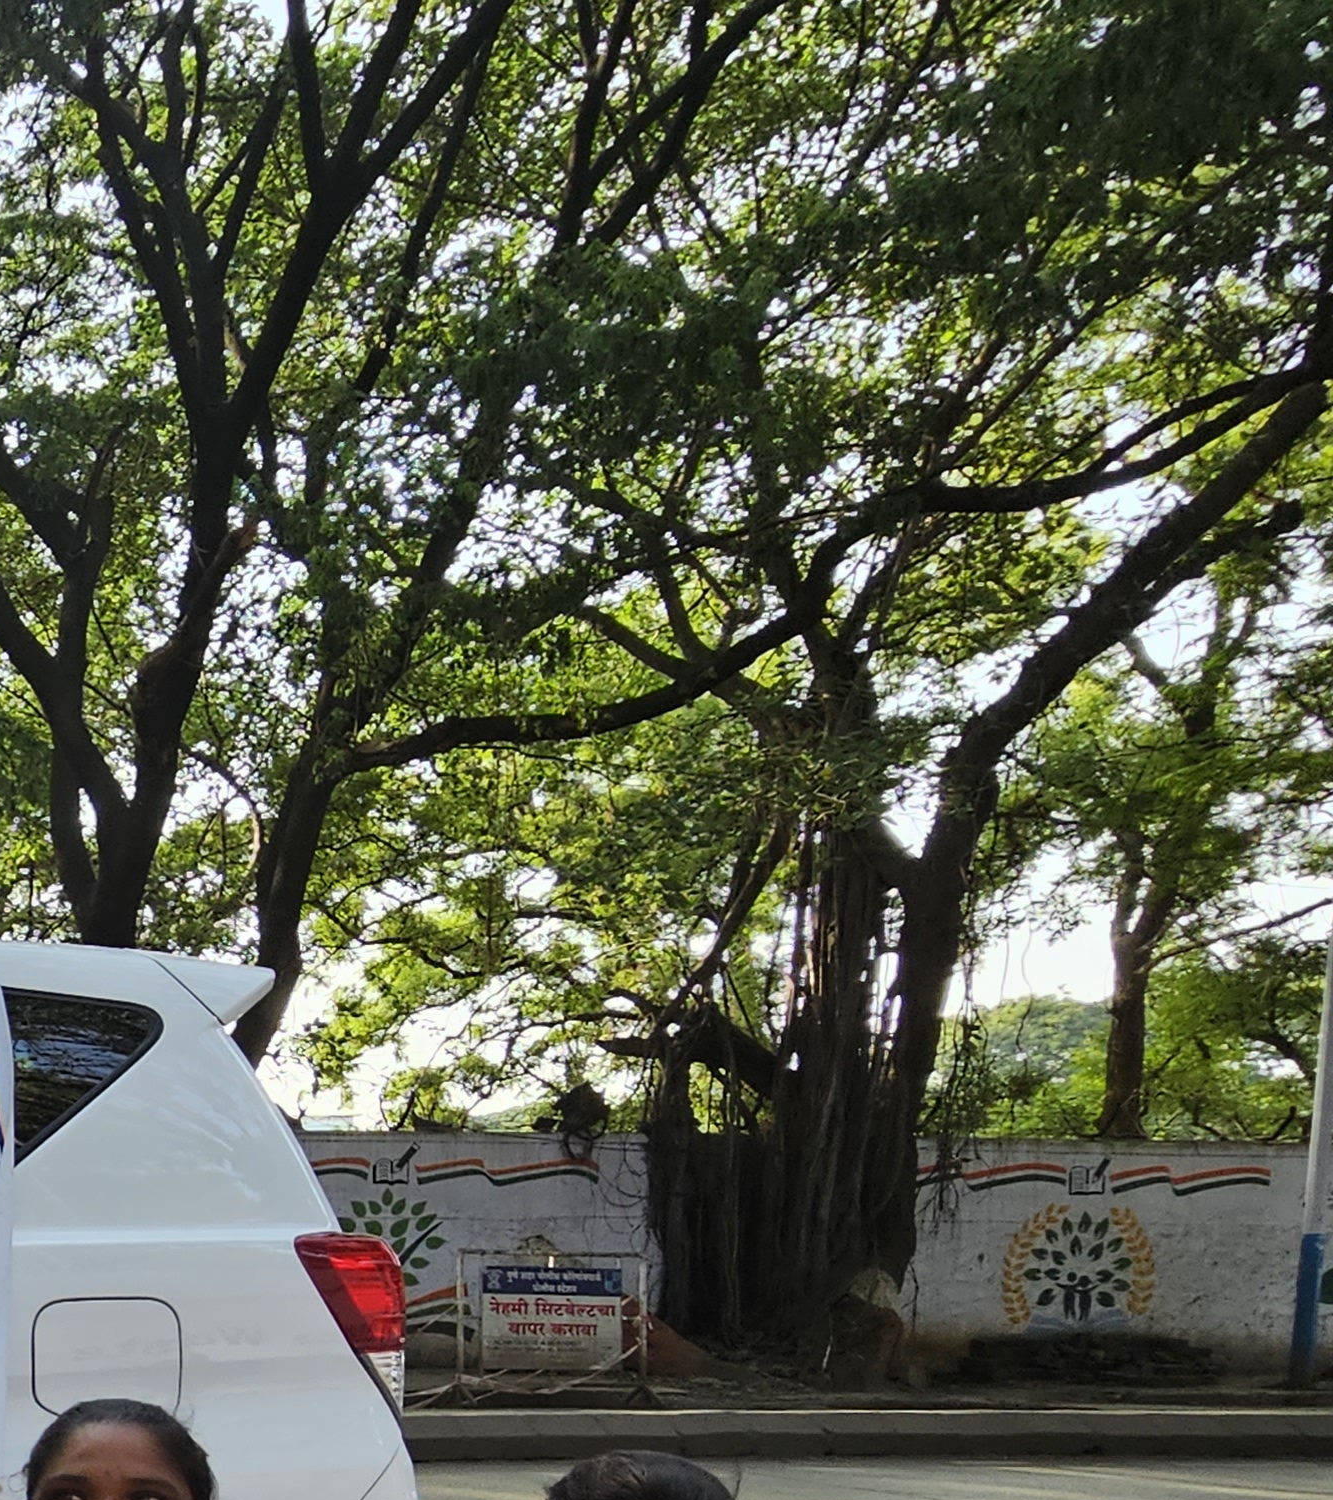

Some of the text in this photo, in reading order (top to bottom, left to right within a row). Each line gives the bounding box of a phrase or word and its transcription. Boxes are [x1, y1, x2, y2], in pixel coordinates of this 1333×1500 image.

[489, 1296, 529, 1316] नेहमी
[507, 1321, 598, 1336] वापर करावा
